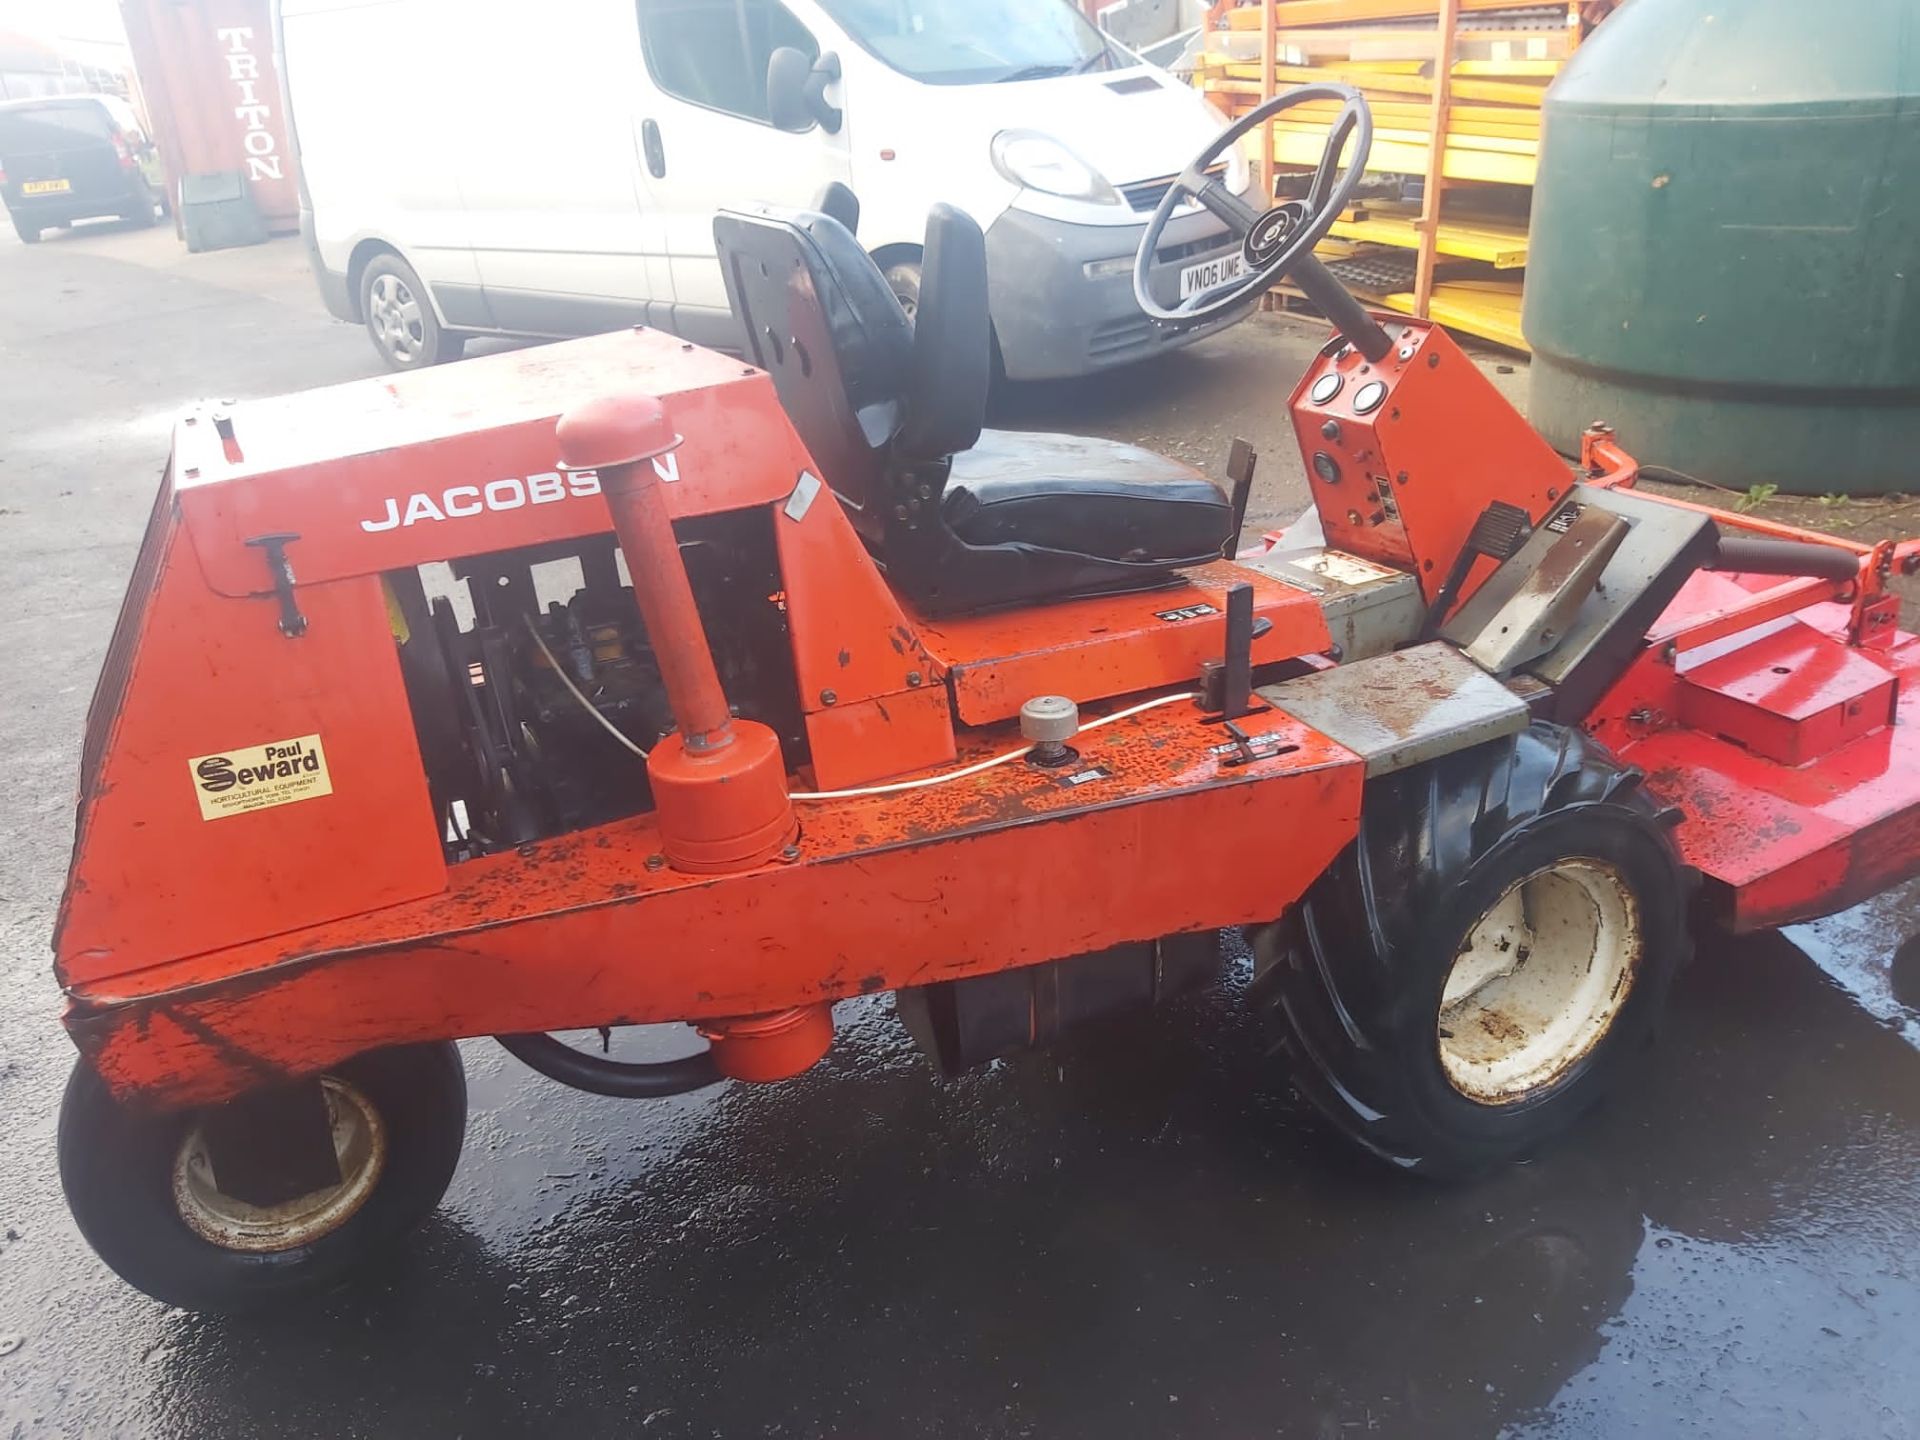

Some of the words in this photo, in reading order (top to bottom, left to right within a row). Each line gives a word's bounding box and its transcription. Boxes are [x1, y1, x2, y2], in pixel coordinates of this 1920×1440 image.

[217, 27, 284, 181] TRITON
[1221, 256, 1241, 282] UME
[360, 453, 681, 533] JACOBSN
[265, 741, 302, 760] Paul
[197, 749, 320, 792] Seward
[210, 787, 271, 805] HORTICULTURAL
[274, 777, 317, 791] EQUIPMENT
